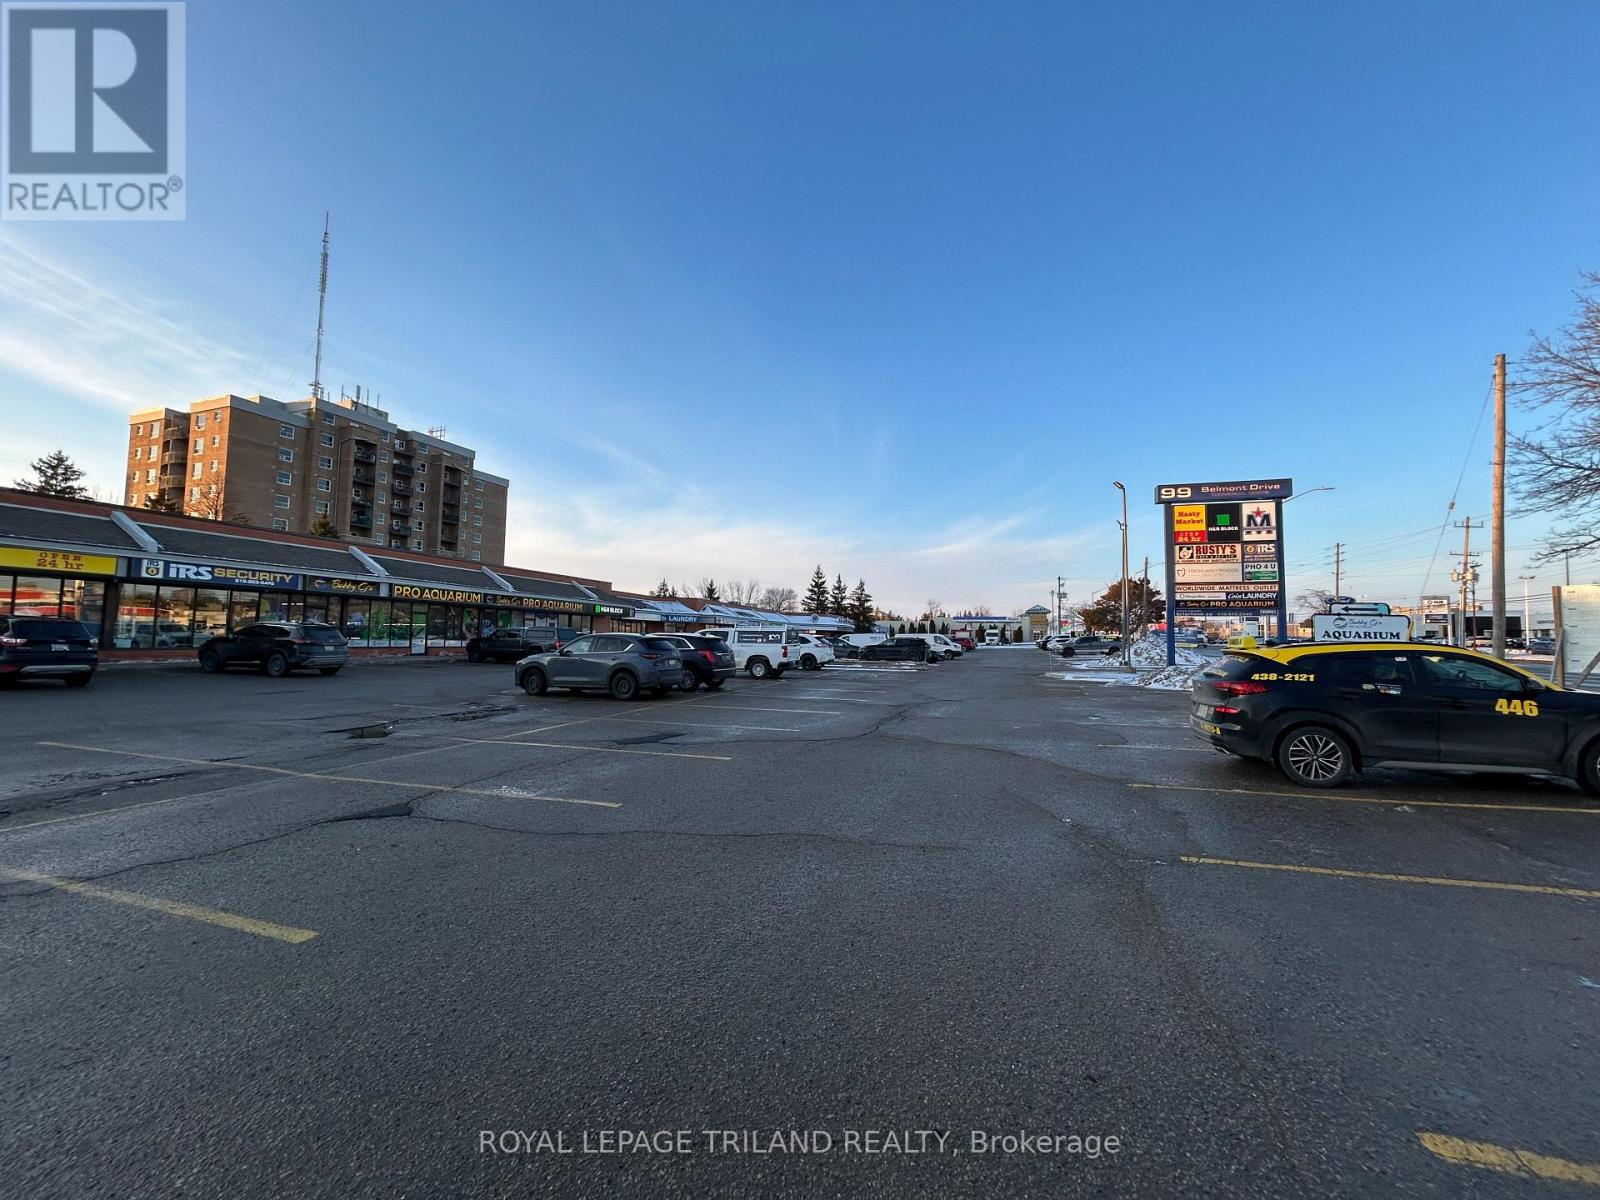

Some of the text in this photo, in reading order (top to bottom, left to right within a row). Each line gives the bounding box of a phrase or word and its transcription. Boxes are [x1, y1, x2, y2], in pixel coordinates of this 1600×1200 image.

[1161, 487, 1191, 499] 99
[1196, 545, 1236, 554] RUSTY'S
[39, 552, 82, 561] OPEN
[37, 559, 84, 570] 24 hr
[214, 568, 293, 583] SECURITY
[331, 579, 356, 592] Bobby
[395, 586, 481, 603] PRO AQUARIUM
[523, 598, 541, 608] PRO
[542, 600, 583, 611] AQUARIUM
[1322, 630, 1401, 640] AQUARIUM
[1251, 673, 1315, 682] 438-2121
[1495, 698, 1539, 717] 446
